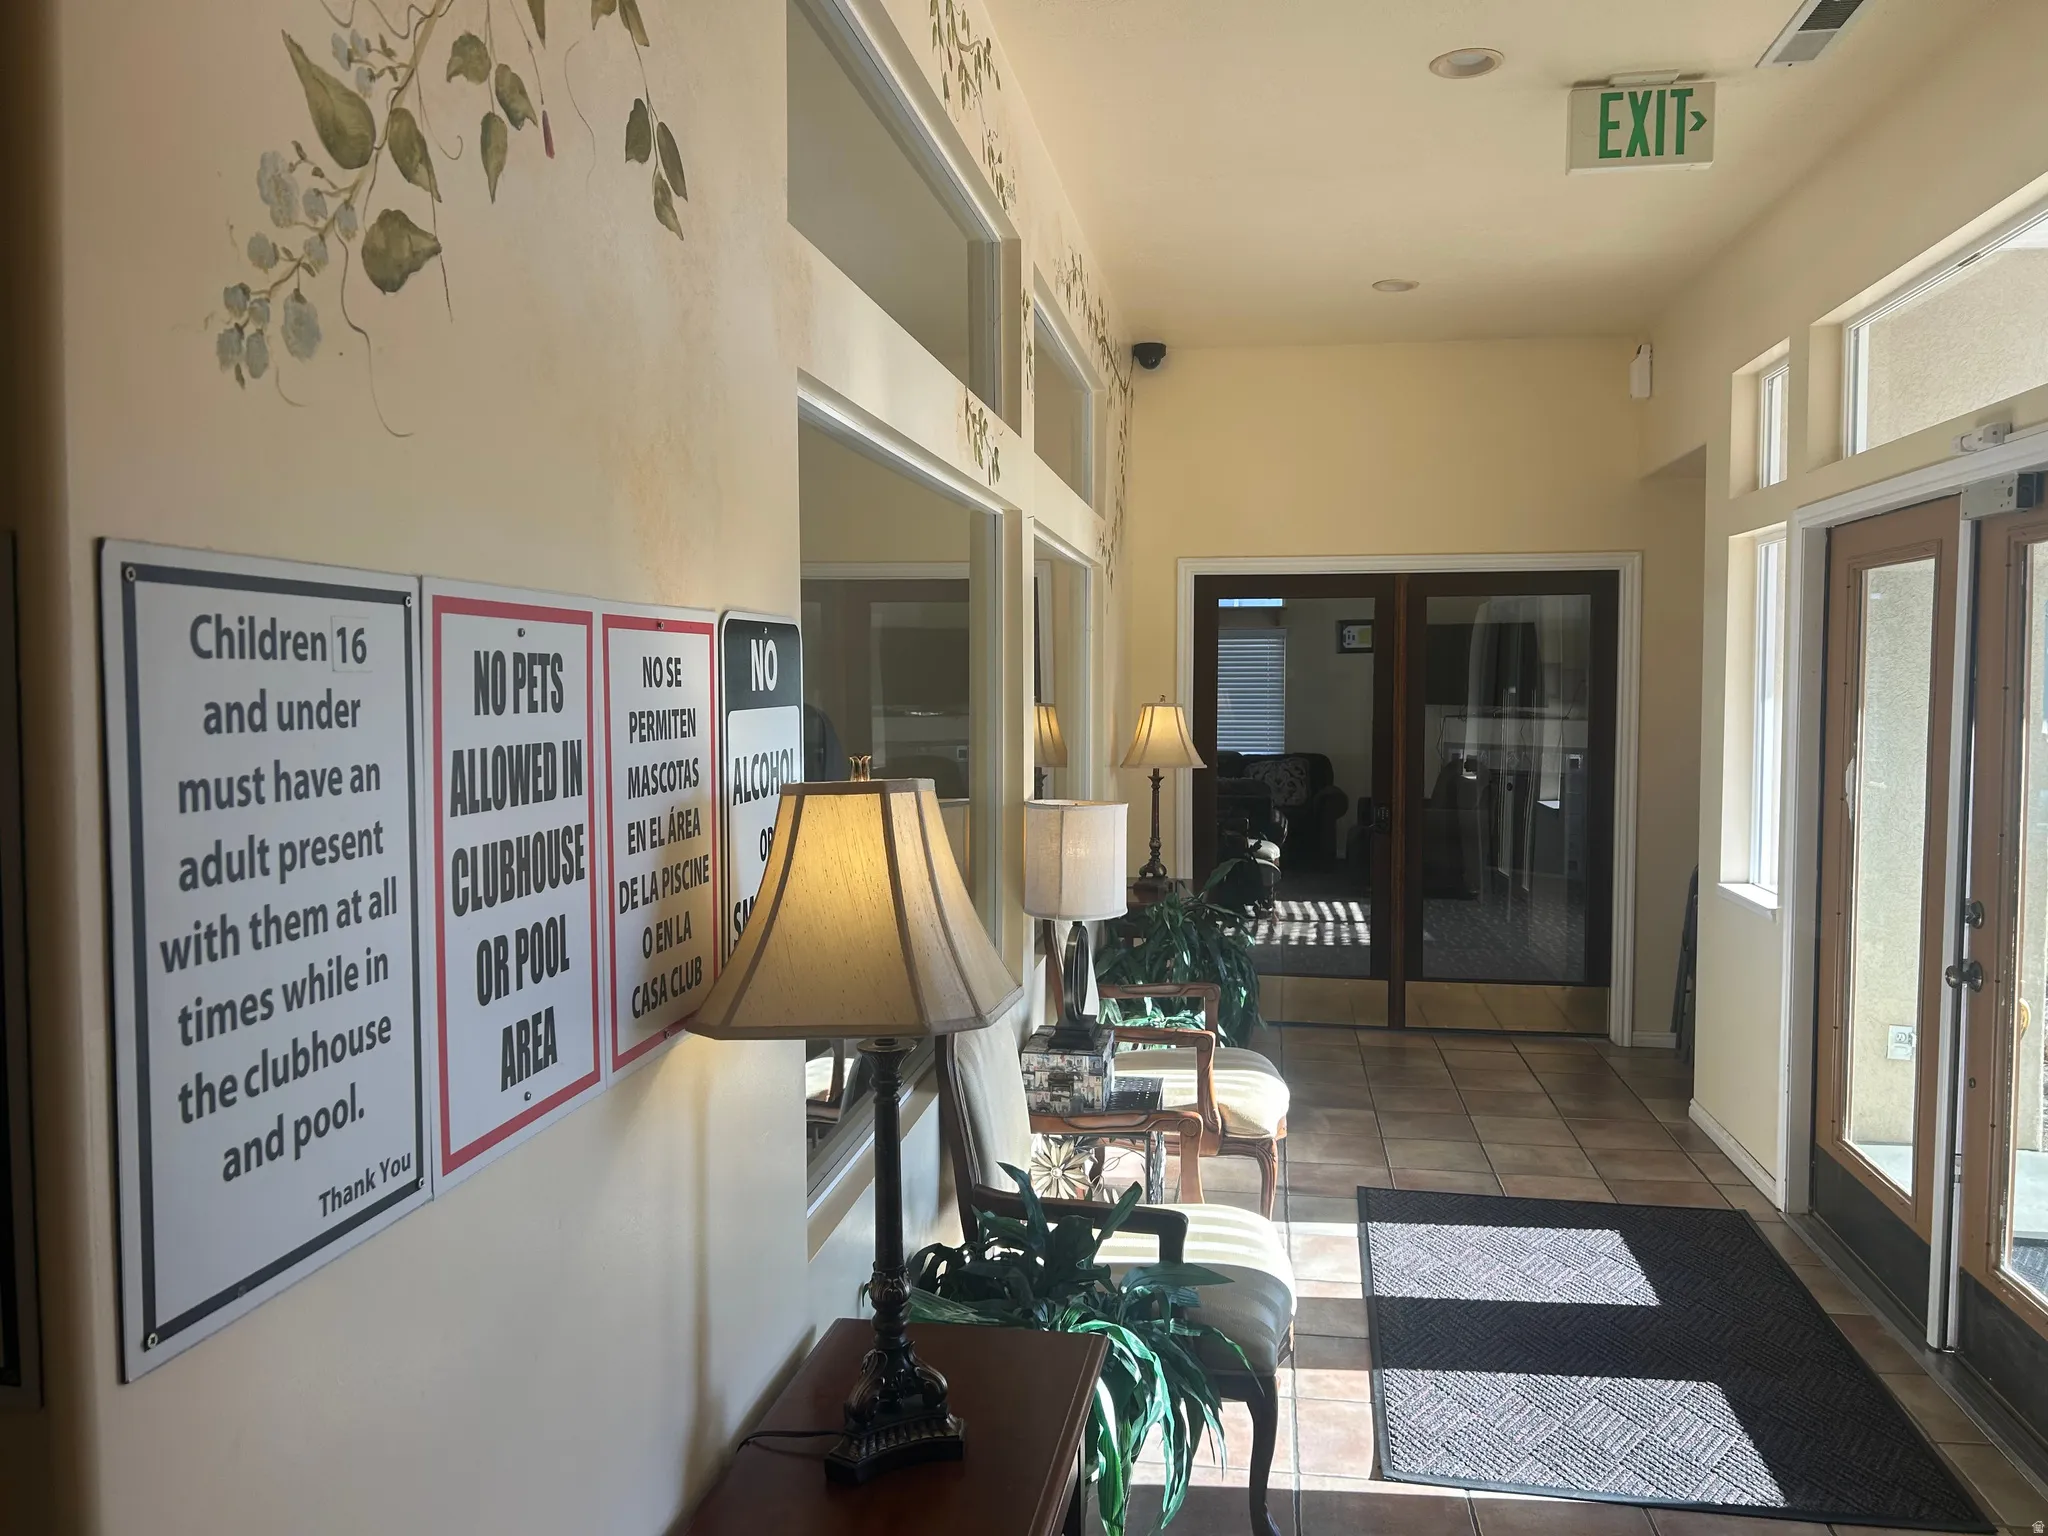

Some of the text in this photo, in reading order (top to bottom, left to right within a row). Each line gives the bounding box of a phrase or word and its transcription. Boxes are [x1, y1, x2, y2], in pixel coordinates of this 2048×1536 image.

[1598, 88, 1694, 159] EXIT
[189, 613, 367, 664] Children 16
[751, 638, 777, 691] NO
[474, 649, 563, 716] NO PETS
[642, 656, 682, 687] NO SE
[203, 688, 360, 734] and under
[629, 708, 696, 743] PERMITEN
[178, 759, 380, 814] must have an
[450, 739, 582, 817] ALLOWED IN
[628, 758, 699, 799] MASCOTAS
[733, 748, 797, 806] ALCOHOL
[179, 821, 383, 891] adult present
[628, 807, 701, 855] EN EL ÁREA
[451, 823, 585, 917] CLUBHOUSE
[619, 854, 709, 914] DE LA PISCINE
[160, 876, 397, 973] with them at all
[642, 911, 691, 959] O EN LA
[476, 914, 570, 1006] OR POOL
[631, 956, 702, 1019] CASA CLUB
[178, 947, 389, 1047] times while in
[178, 1015, 392, 1125] the clubhouse
[501, 1006, 557, 1092] AREA
[222, 1082, 365, 1181] and pool.
[318, 1152, 411, 1217] Thank You
